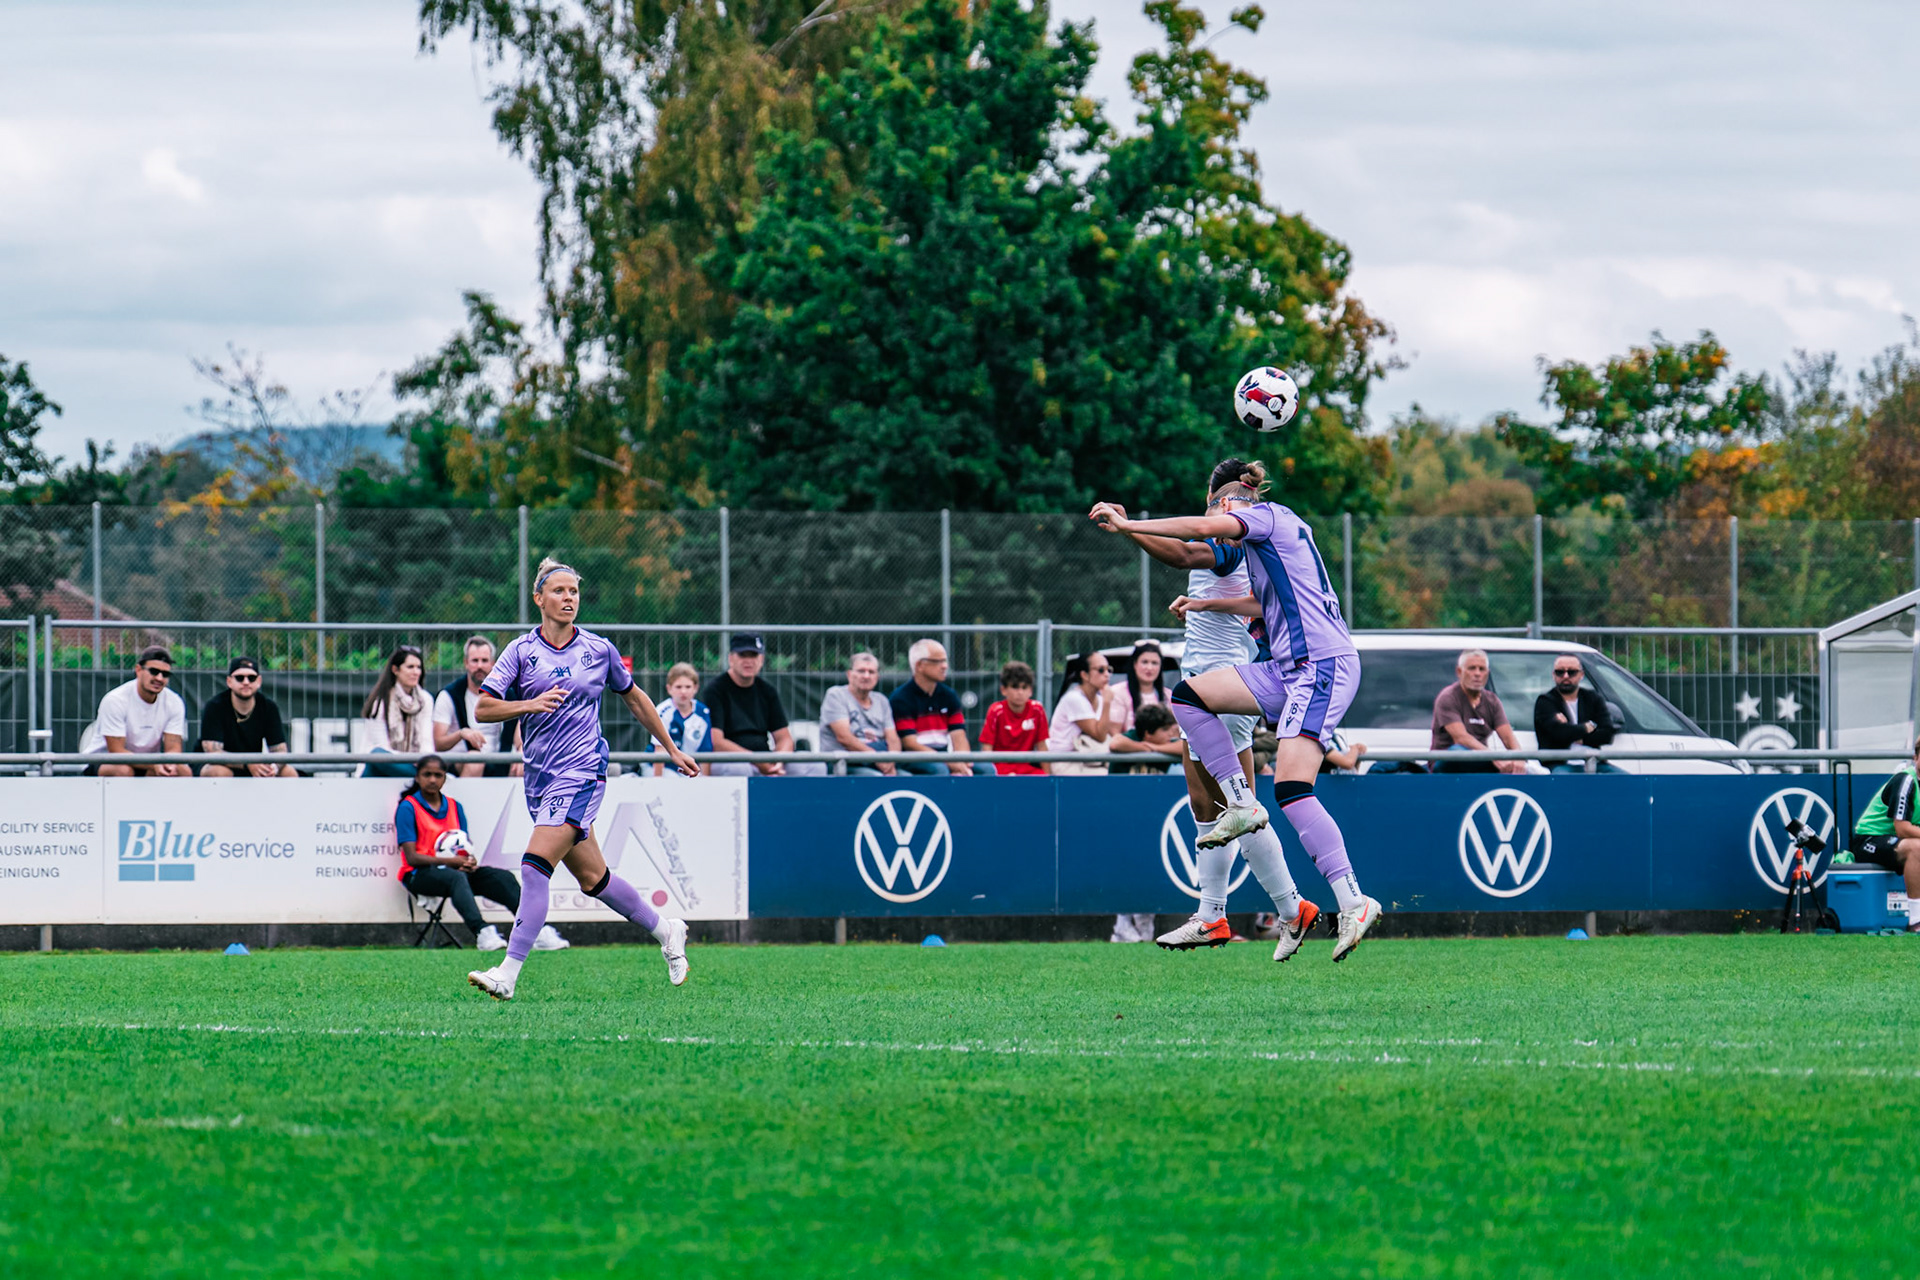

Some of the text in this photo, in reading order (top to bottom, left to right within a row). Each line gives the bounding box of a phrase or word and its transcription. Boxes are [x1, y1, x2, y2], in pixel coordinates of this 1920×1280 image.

[548, 666, 572, 678] AXA
[550, 796, 564, 807] 20
[0, 822, 95, 834] CILITY SERVICE
[315, 822, 367, 834] FACILITY
[120, 820, 295, 860] Blue service
[315, 844, 401, 856] HAUSWARTU
[315, 866, 388, 878] REINIGUNG
